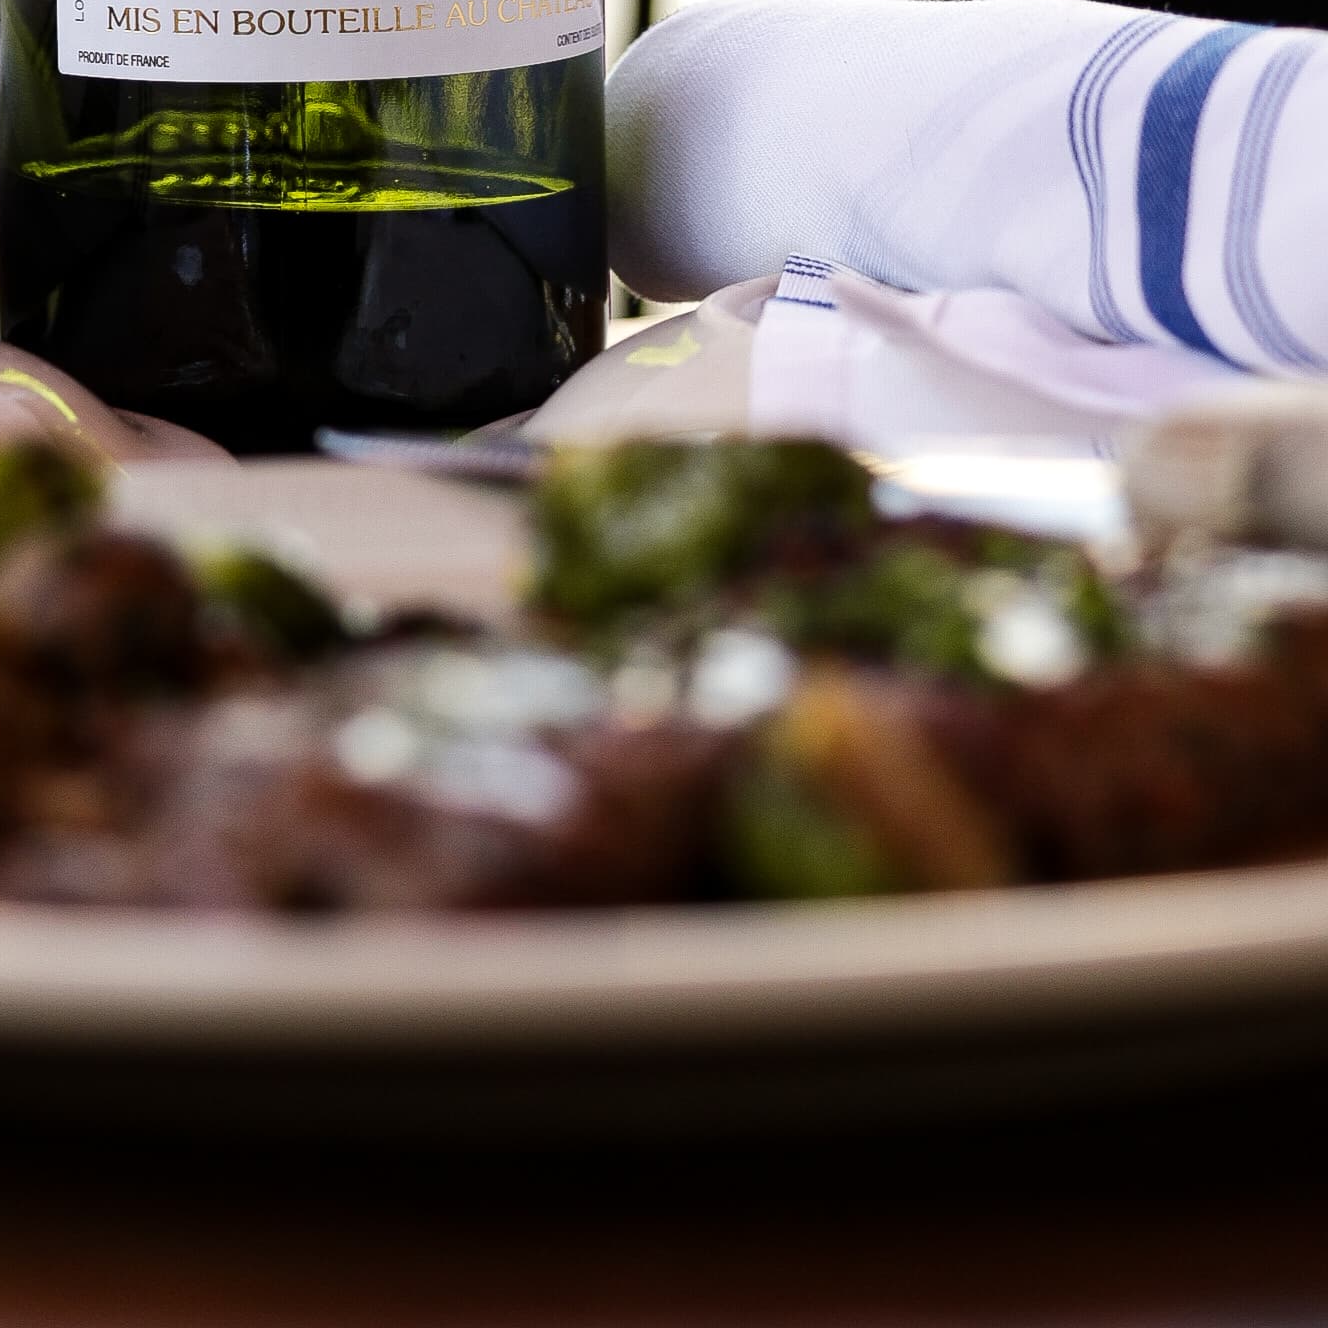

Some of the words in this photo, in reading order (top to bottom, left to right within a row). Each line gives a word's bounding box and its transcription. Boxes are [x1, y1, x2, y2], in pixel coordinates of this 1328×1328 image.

[107, 6, 161, 33] MIS
[172, 8, 220, 34] EN
[232, 3, 436, 36] BOUTEILLE
[445, 0, 489, 28] AU
[78, 50, 115, 65] PRODUIT
[116, 53, 129, 66] DE
[130, 54, 171, 68] FRANCE
